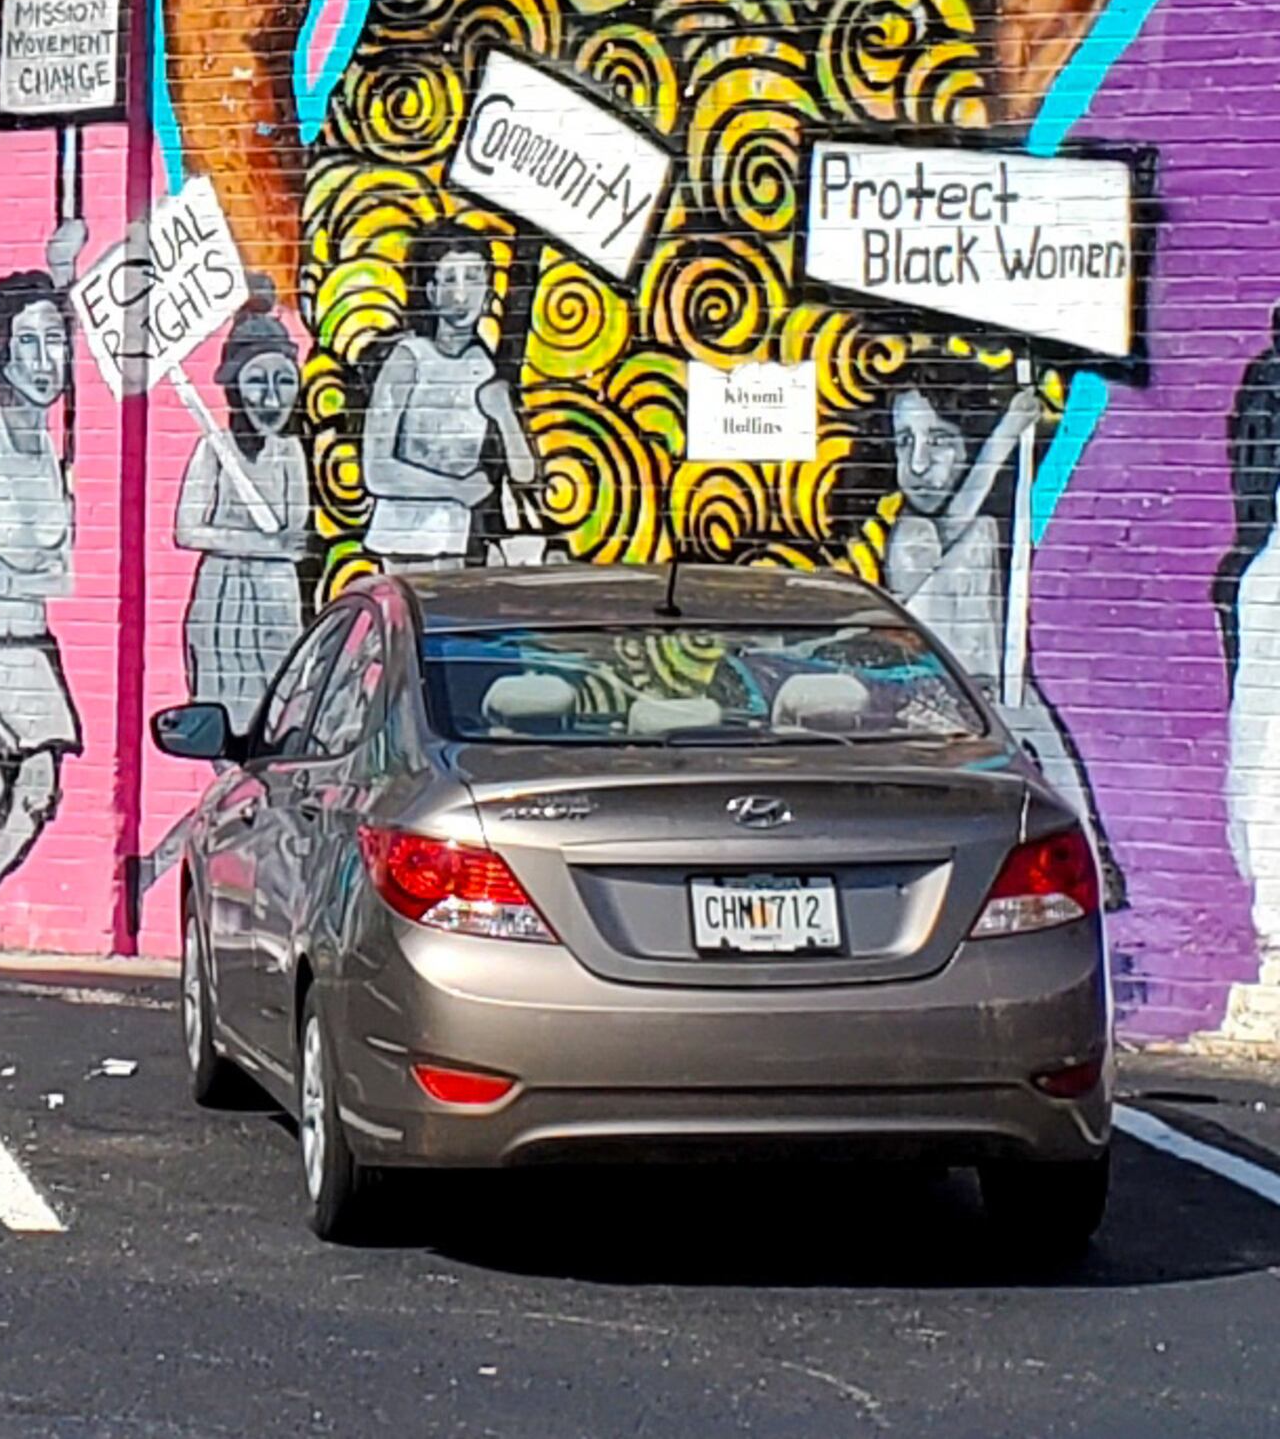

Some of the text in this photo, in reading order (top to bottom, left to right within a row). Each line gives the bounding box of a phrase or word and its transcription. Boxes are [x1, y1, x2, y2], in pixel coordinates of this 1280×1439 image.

[7, 30, 114, 58] MOVEMENT
[15, 0, 106, 27] MISSION
[19, 61, 110, 95] CHANGE
[465, 93, 652, 249] Community
[820, 151, 1020, 223] Protect
[81, 204, 219, 329] EQUAL
[863, 225, 1127, 286] Black Women
[102, 250, 234, 374] RIGHTS
